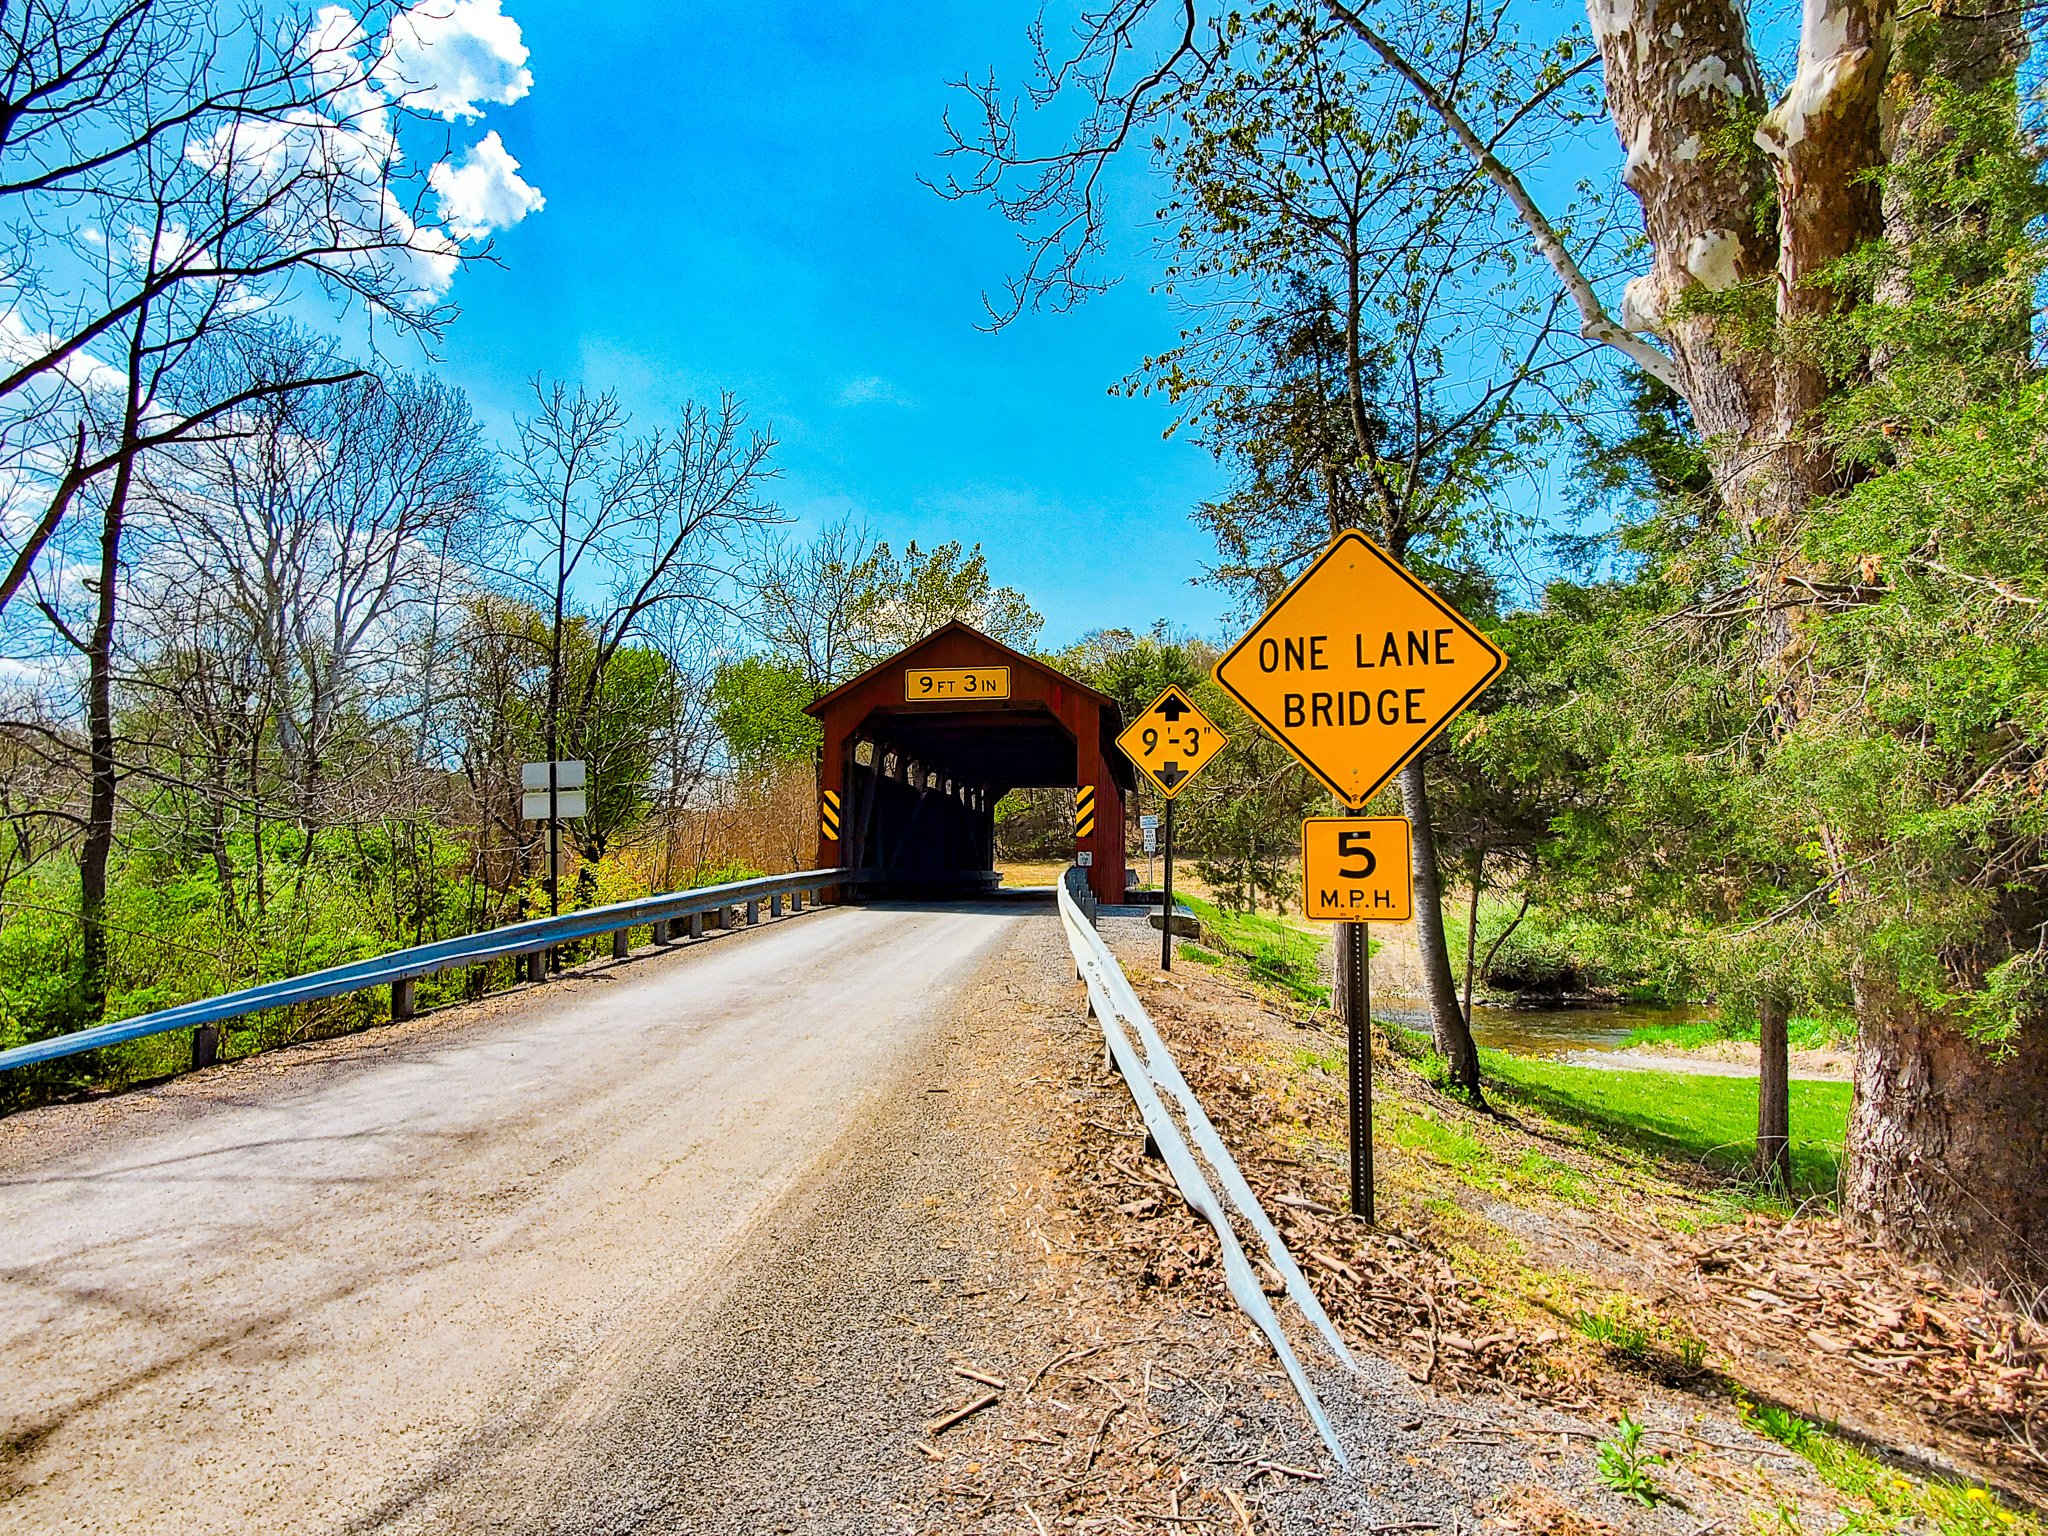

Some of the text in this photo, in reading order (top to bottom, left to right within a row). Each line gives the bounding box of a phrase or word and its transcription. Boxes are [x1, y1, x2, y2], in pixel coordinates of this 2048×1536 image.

[1258, 628, 1456, 673] ONE LANE
[919, 674, 997, 694] 9 FT 3 IN
[1283, 688, 1427, 728] BRIDGE
[1337, 830, 1378, 880] 5
[1320, 888, 1396, 909] M.P.H.
